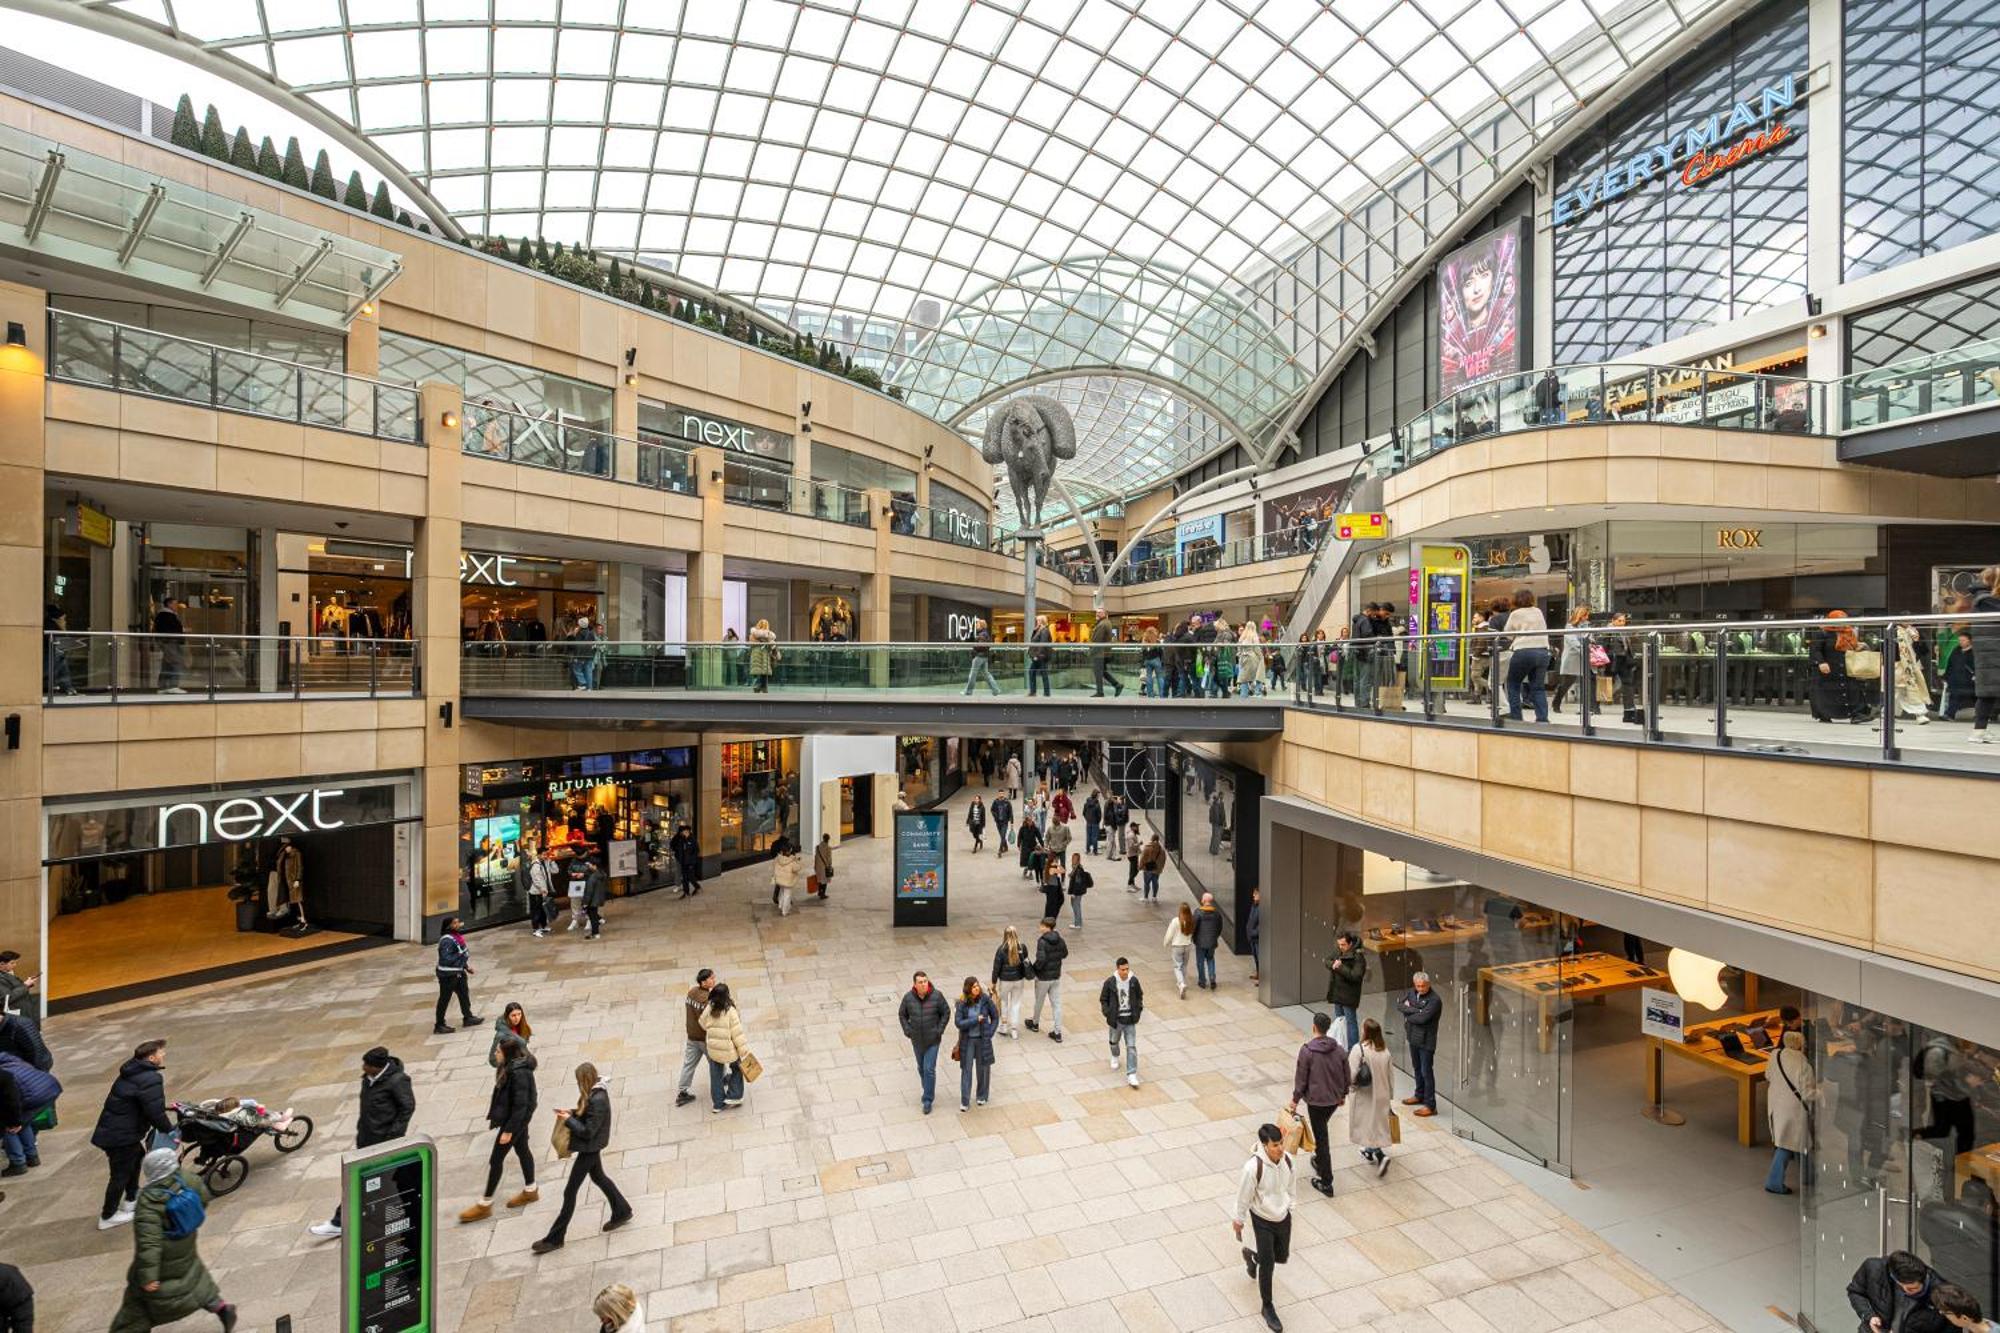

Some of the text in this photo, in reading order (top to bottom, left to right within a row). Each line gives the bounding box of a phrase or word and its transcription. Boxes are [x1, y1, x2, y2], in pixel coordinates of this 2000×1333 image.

[1553, 75, 1796, 225] EVERYMAN
[1682, 121, 1790, 186] Cinema
[683, 415, 755, 453] next
[948, 507, 981, 545] next
[1718, 529, 1763, 548] ROX
[158, 788, 344, 848] next
